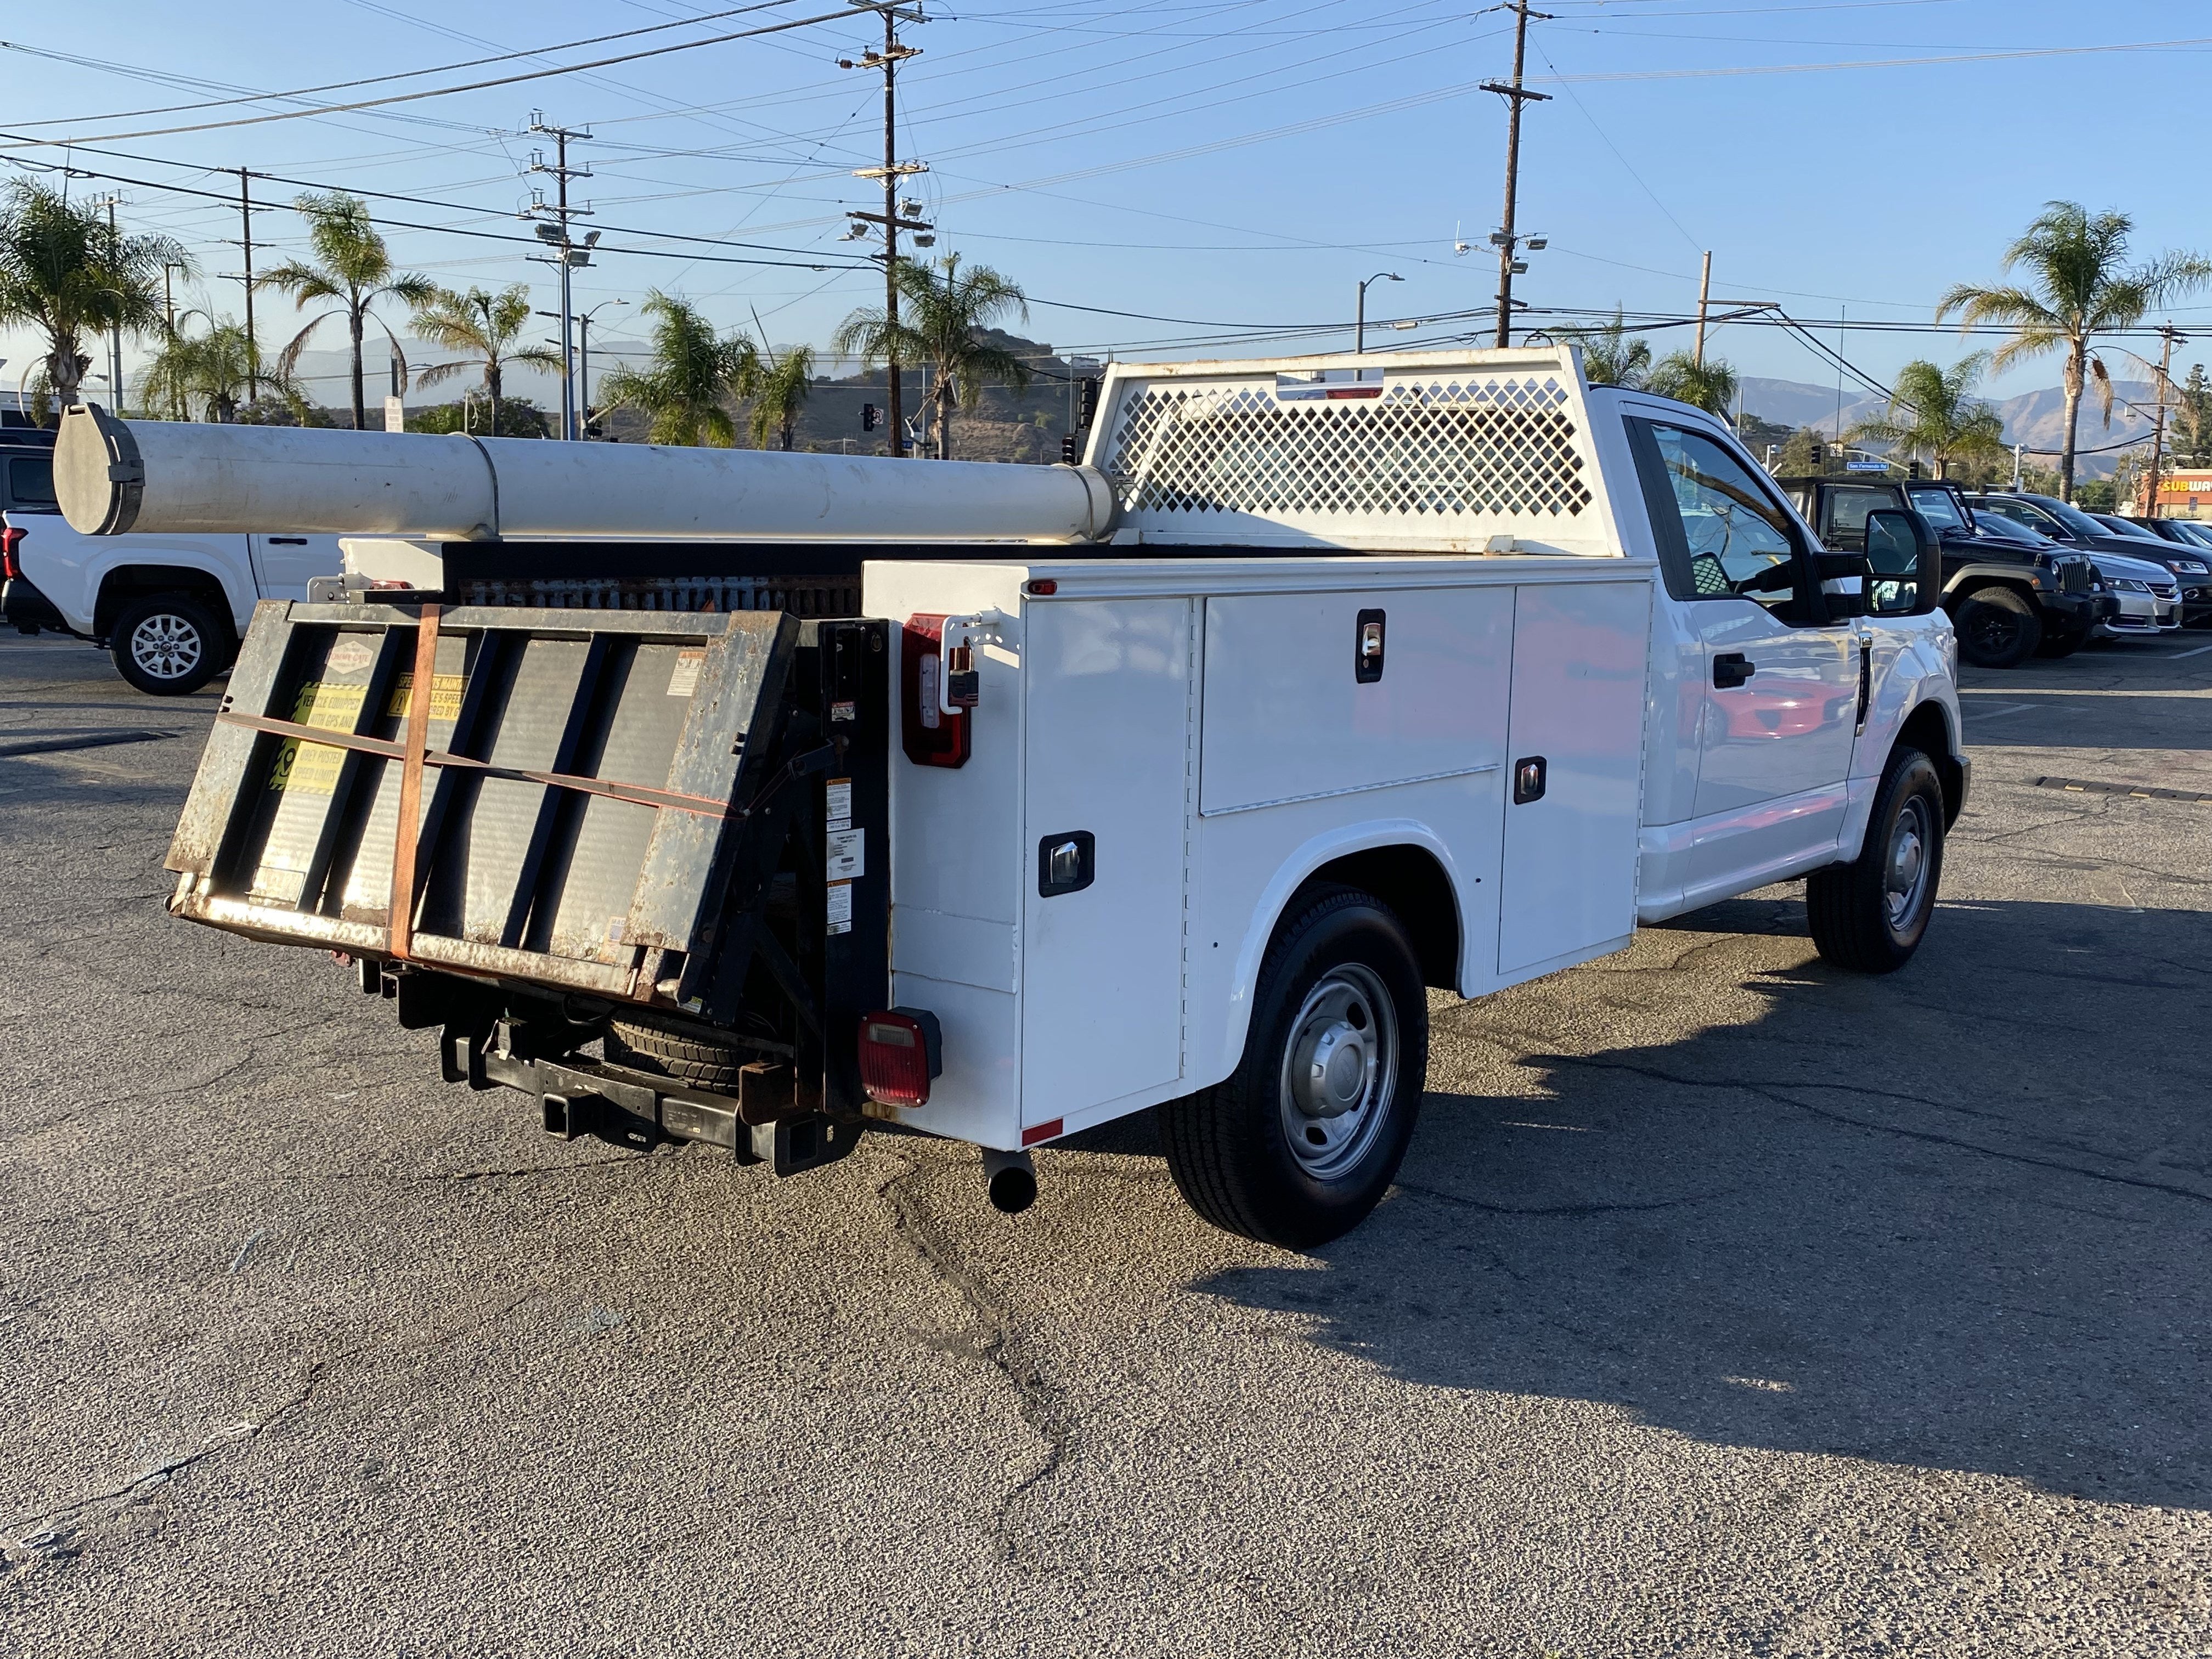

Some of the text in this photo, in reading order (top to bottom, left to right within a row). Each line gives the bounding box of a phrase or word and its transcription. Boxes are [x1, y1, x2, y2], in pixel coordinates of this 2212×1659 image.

[2161, 481, 2212, 492] SUBWA
[330, 653, 351, 661] OMMY
[302, 695, 361, 710] VEHICLE EQUIPPED
[444, 706, 455, 717] BY
[308, 713, 355, 728] WITH GPS AND
[300, 748, 342, 764] OBEY POSTED
[292, 766, 337, 782] SPEED LIMITS
